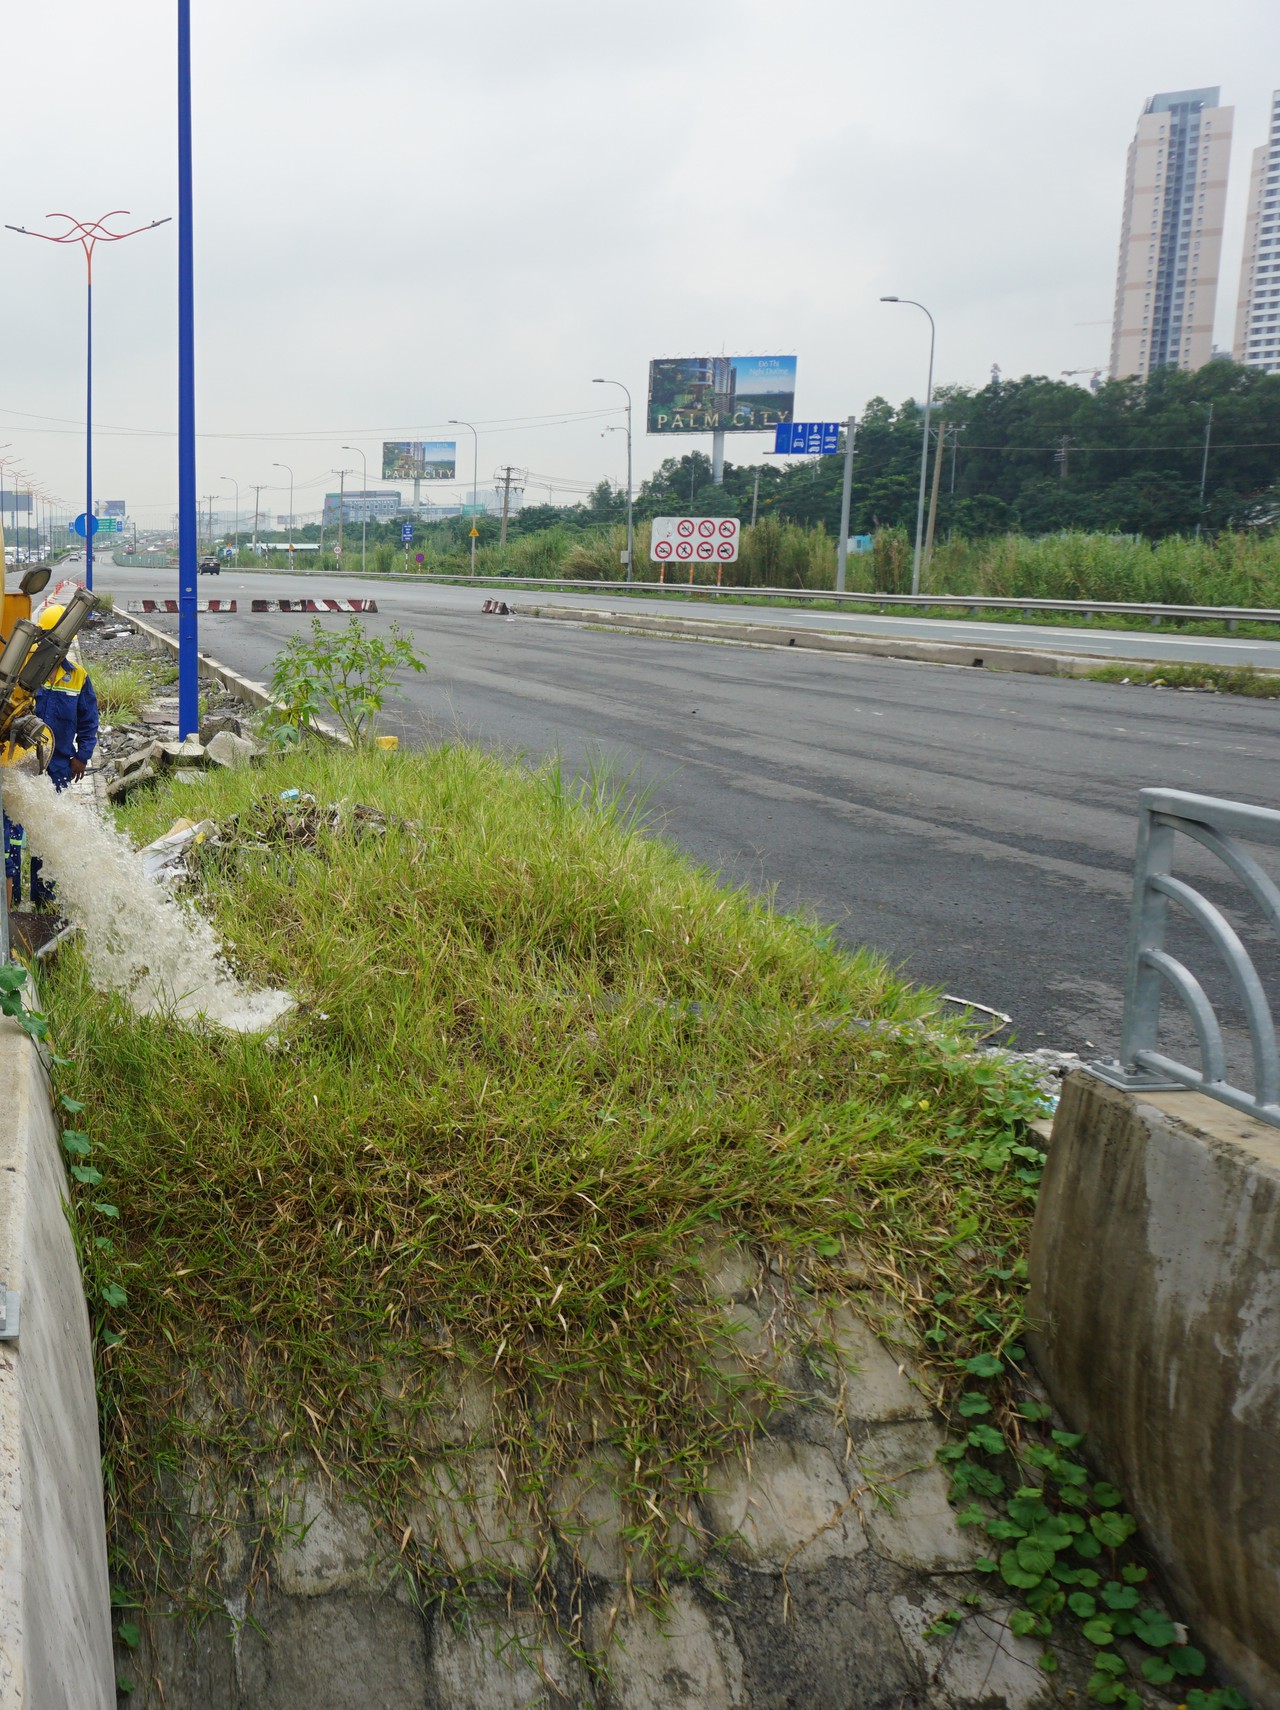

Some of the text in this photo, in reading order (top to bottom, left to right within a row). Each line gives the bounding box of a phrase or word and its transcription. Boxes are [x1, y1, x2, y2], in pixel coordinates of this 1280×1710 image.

[657, 410, 789, 429] PALM CITY
[385, 469, 453, 478] PALM CITY
